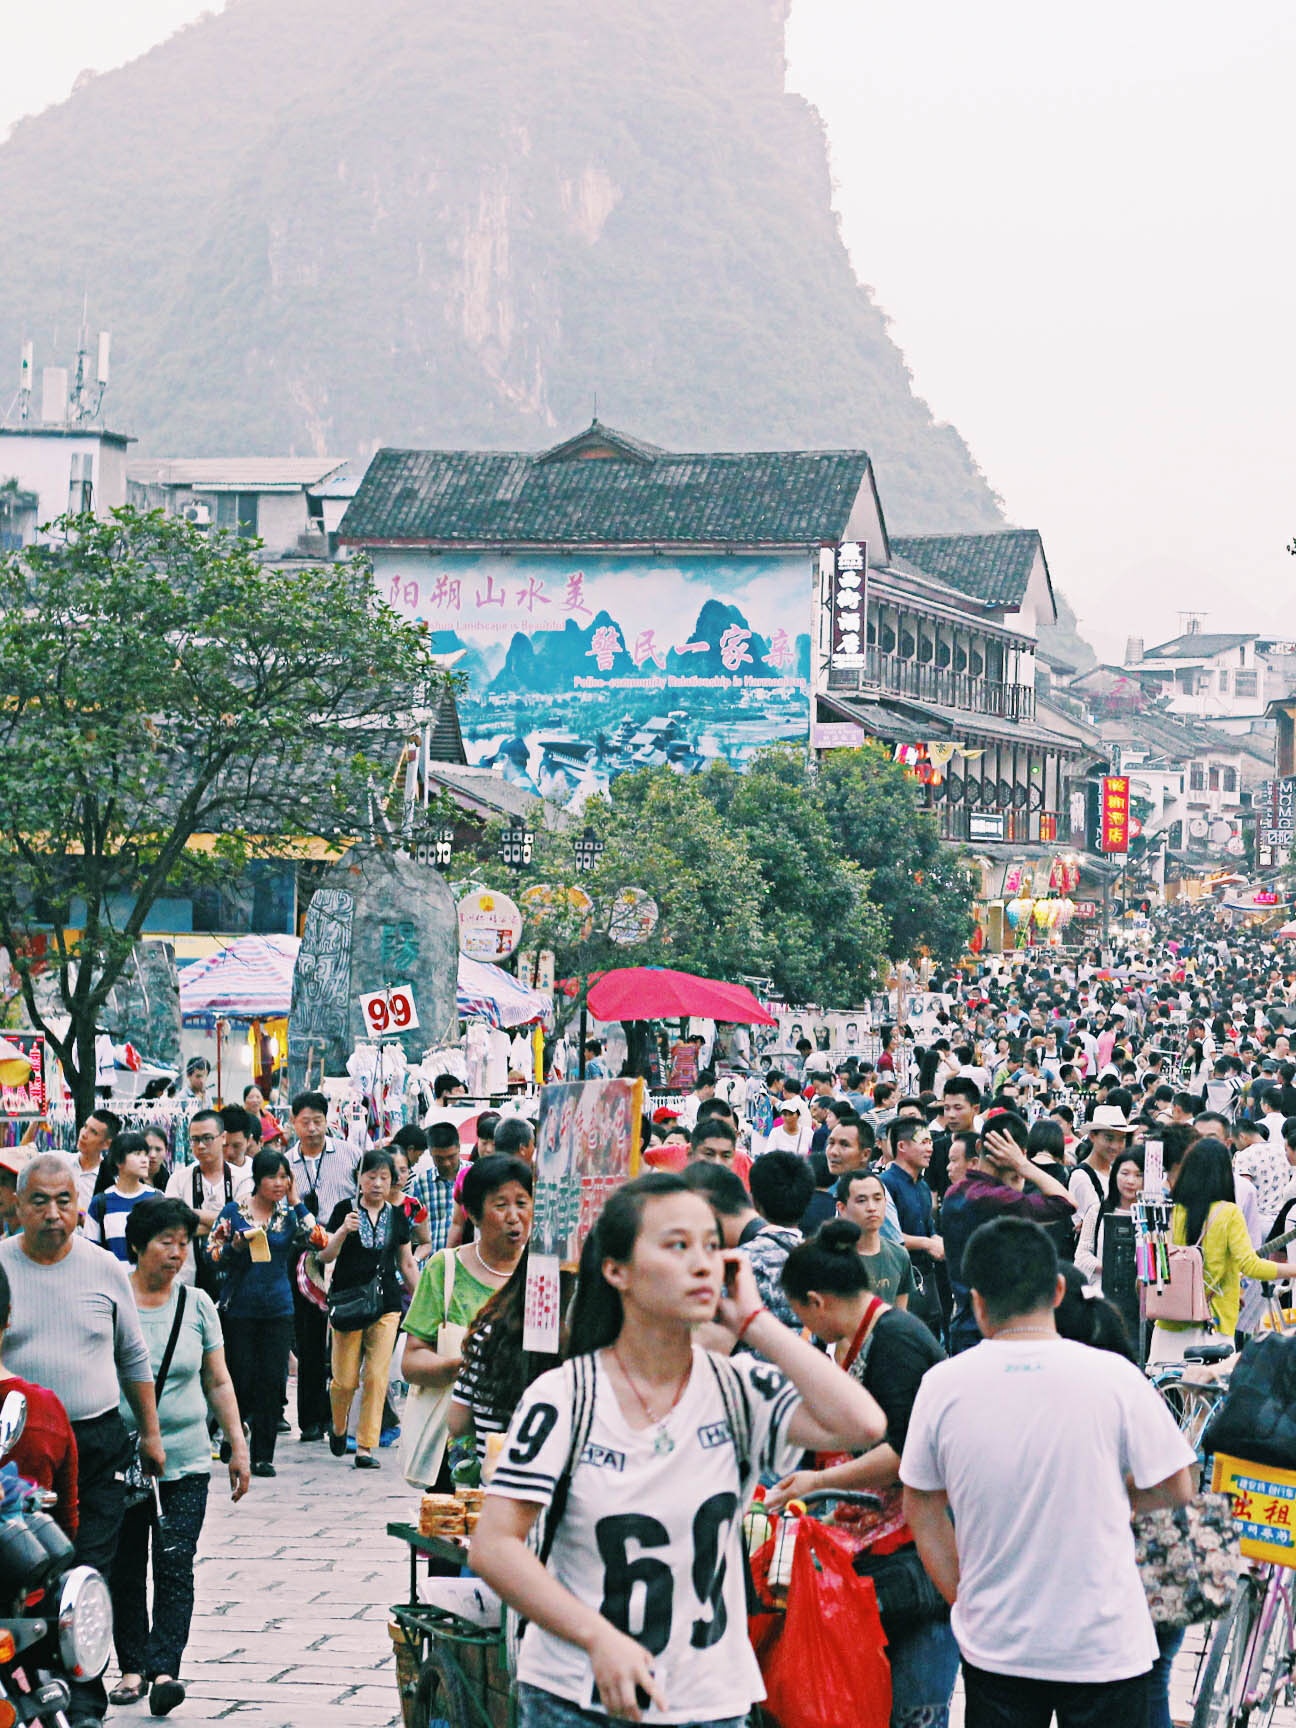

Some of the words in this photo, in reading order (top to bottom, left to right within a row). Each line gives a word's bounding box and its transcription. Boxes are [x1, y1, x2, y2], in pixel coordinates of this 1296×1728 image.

[390, 572, 593, 616] 阳朔山水美
[585, 624, 795, 670] 警民一家亲
[1279, 781, 1293, 829] MOMO
[367, 993, 412, 1031] 99
[509, 1403, 558, 1465] 9
[1231, 1489, 1292, 1526] 出租
[595, 1491, 739, 1657] 69
